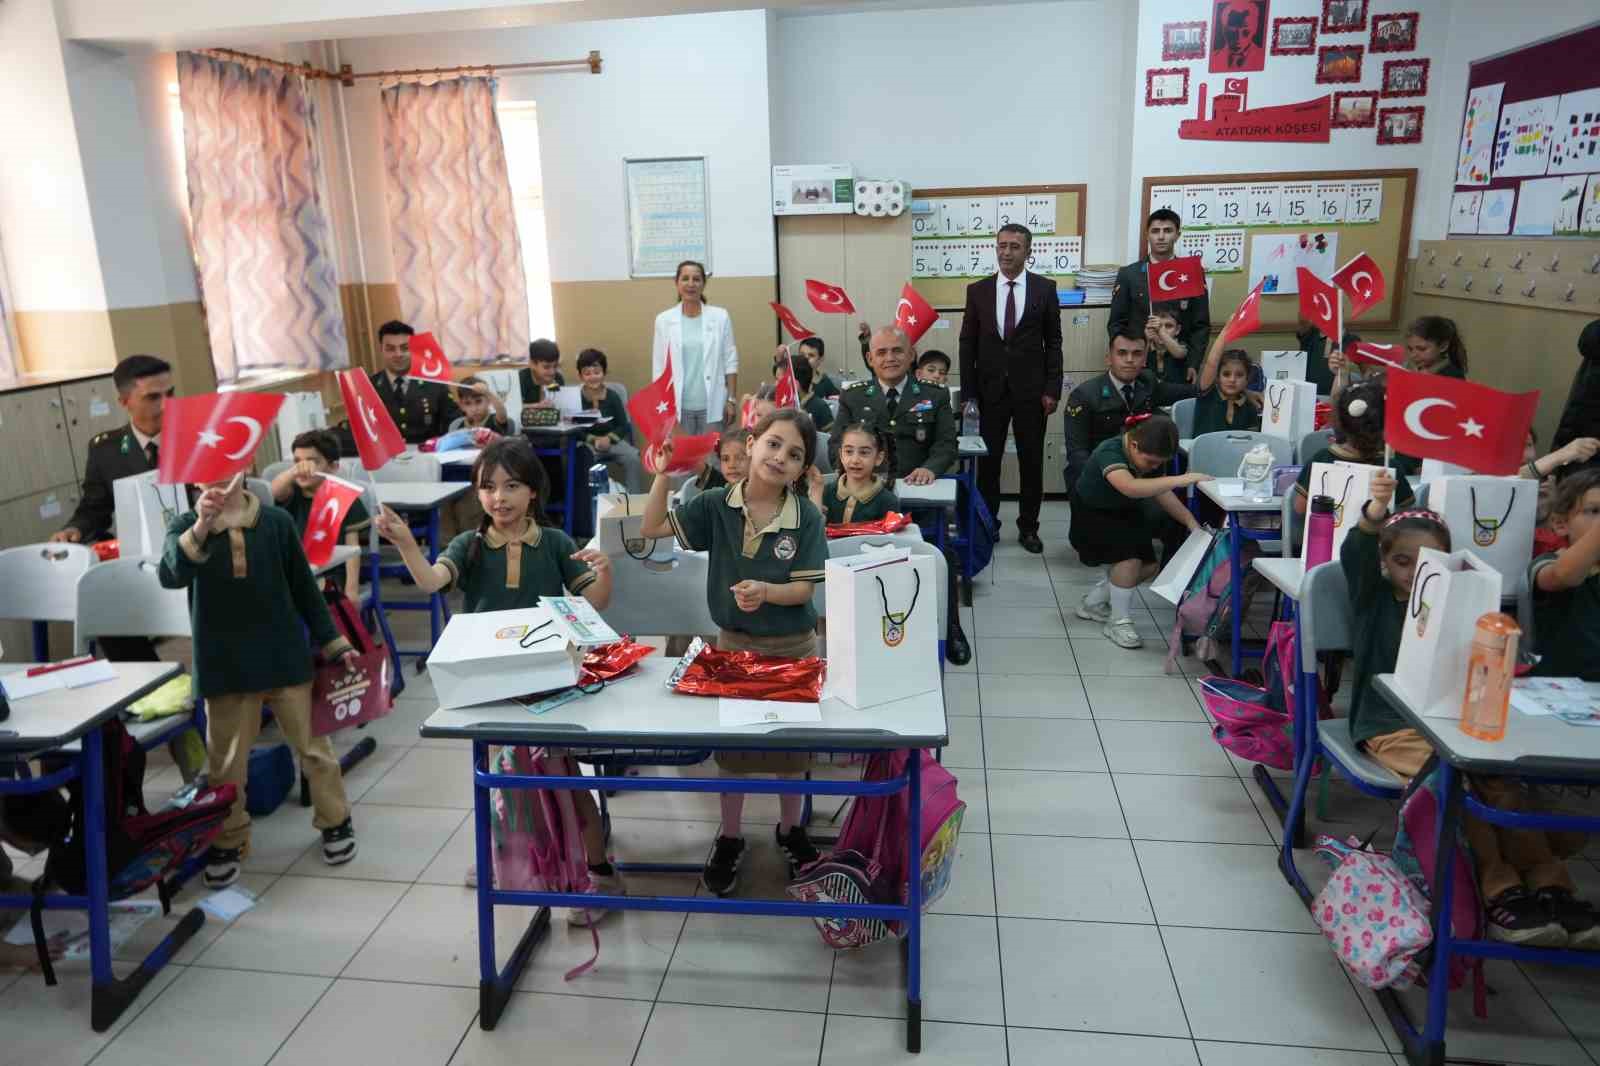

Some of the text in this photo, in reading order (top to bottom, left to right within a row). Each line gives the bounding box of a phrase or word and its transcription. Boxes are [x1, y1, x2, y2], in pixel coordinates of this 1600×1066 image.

[1215, 122, 1321, 136] ATATÜRK KÖŞESİ
[1191, 203, 1208, 219] 12
[1223, 202, 1239, 218] 13
[1255, 201, 1272, 217] 14
[1289, 200, 1305, 216] 15
[1322, 200, 1338, 216] 16
[1355, 199, 1373, 215] 17
[914, 218, 925, 232] 0
[972, 216, 983, 231] 2
[1028, 214, 1038, 228] 4
[1027, 255, 1036, 269] 9
[1054, 255, 1069, 269] 10
[1215, 248, 1240, 264] 20
[915, 258, 928, 272] 5
[943, 257, 953, 272] 6
[971, 257, 980, 271] 7
